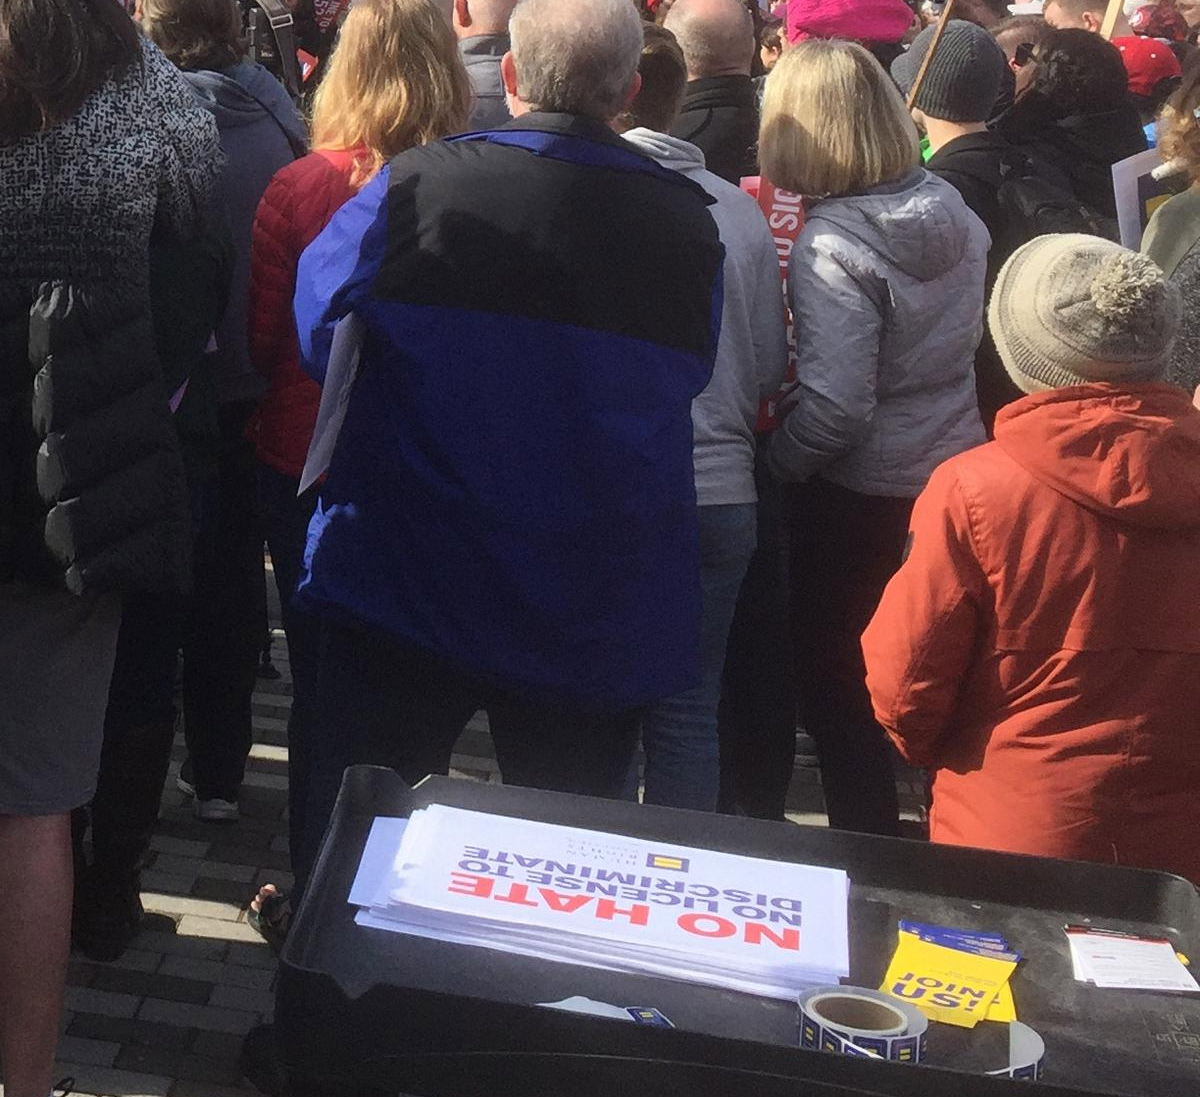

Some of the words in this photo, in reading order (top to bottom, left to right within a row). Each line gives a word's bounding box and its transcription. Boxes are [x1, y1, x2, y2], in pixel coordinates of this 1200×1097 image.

[769, 187, 803, 232] SIG
[458, 859, 514, 878] TO
[462, 845, 802, 912] DISCRIMINATE
[447, 871, 650, 926] HATE
[525, 869, 719, 912] LICENSE
[676, 912, 801, 950] NO
[731, 904, 802, 926] NO
[891, 982, 980, 1012] US!
[898, 972, 987, 998] JOIN
